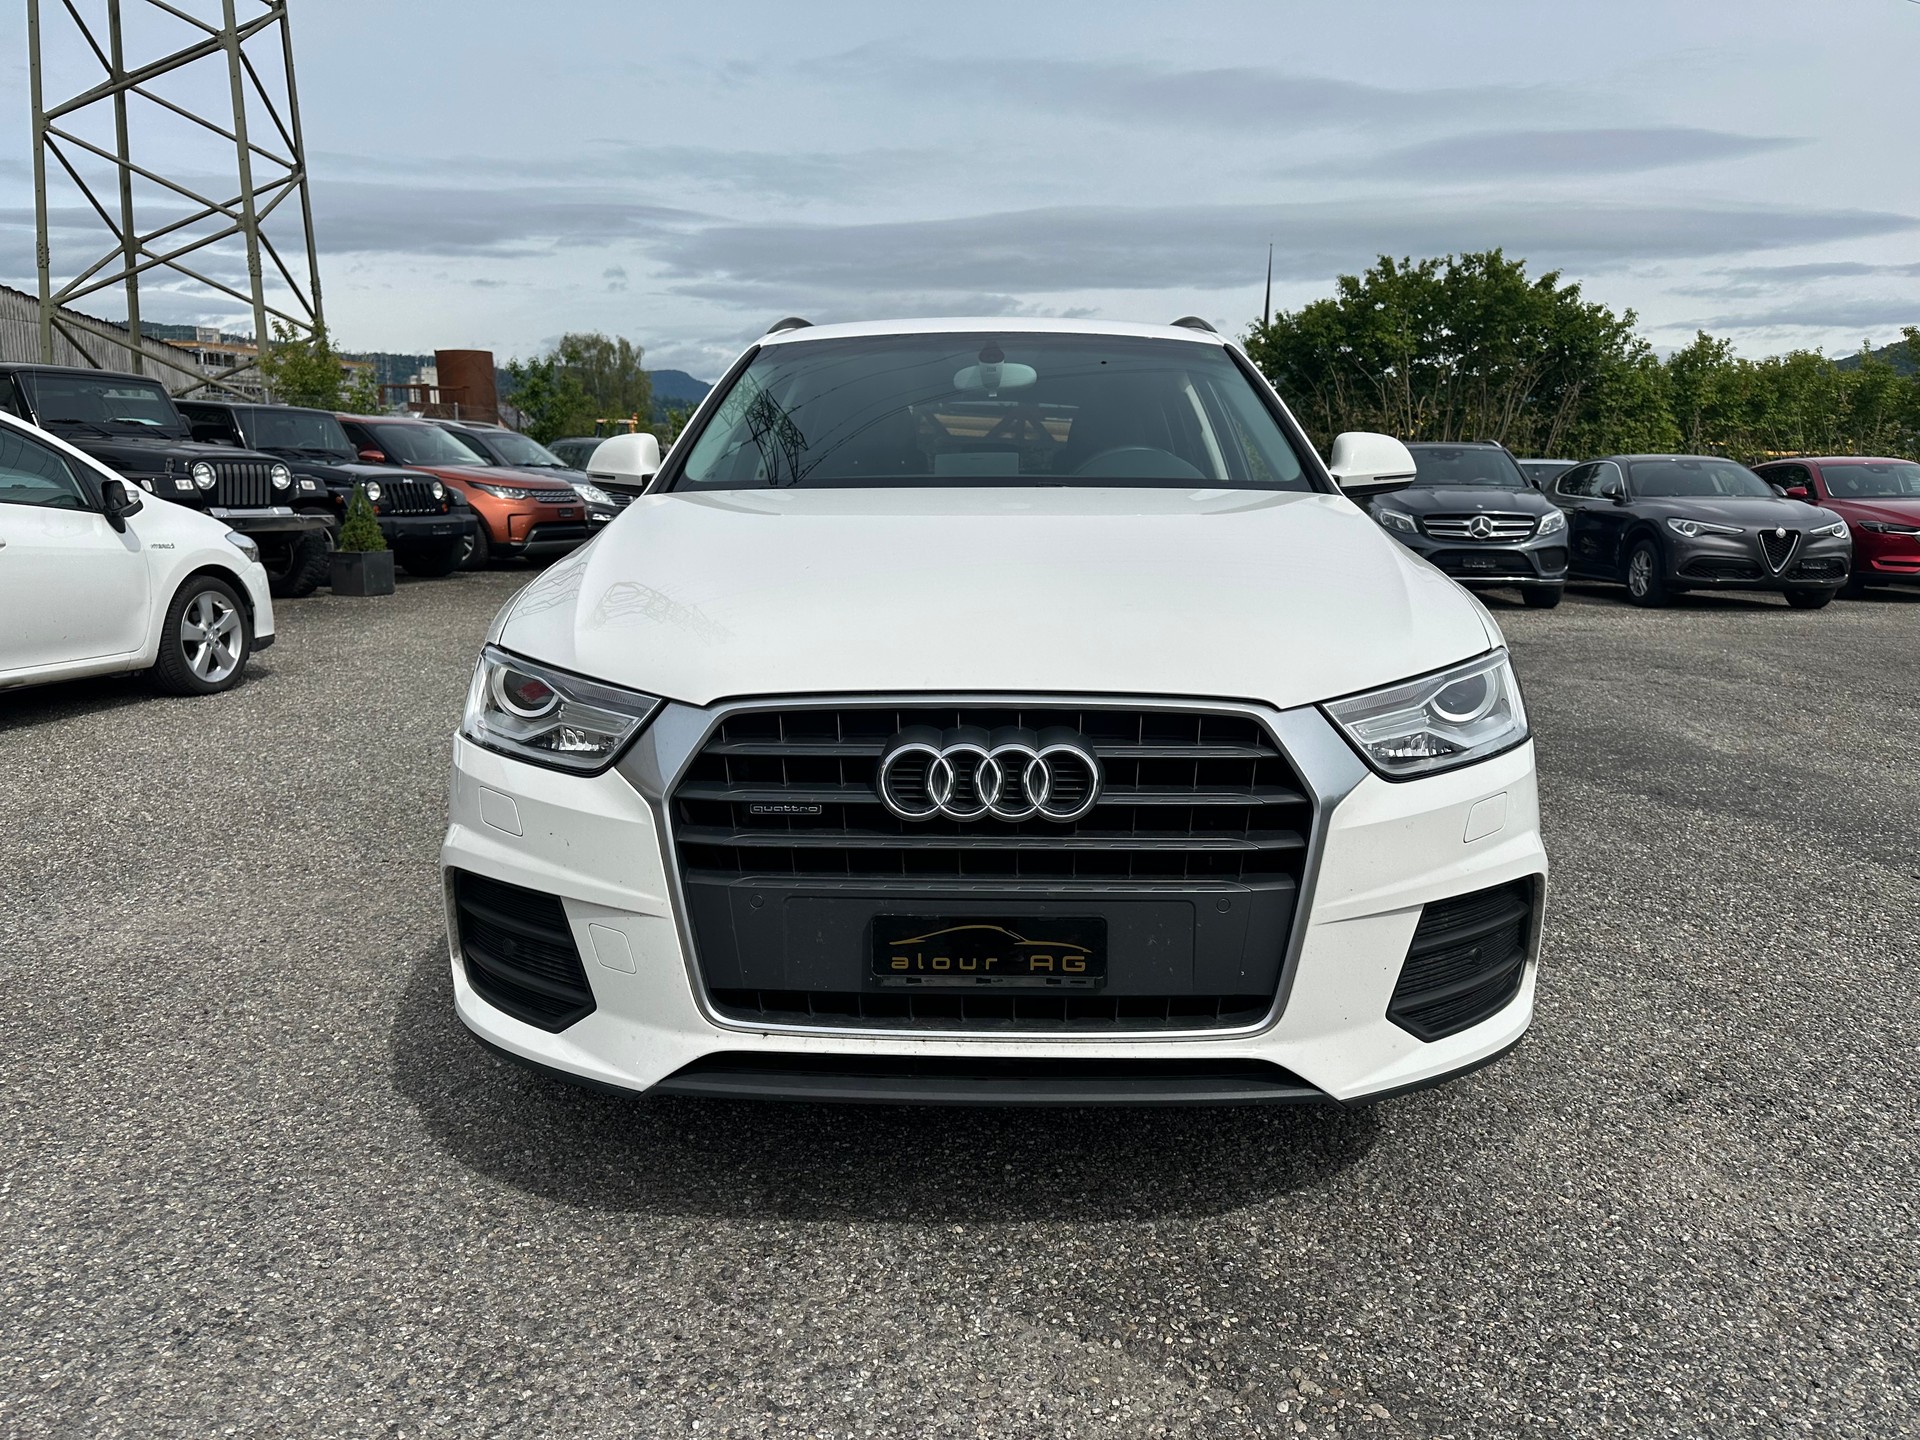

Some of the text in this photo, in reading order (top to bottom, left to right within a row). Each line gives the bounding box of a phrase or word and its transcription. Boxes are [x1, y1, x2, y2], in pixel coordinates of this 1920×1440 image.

[753, 805, 818, 813] quattro
[891, 953, 1086, 972] alour AG
